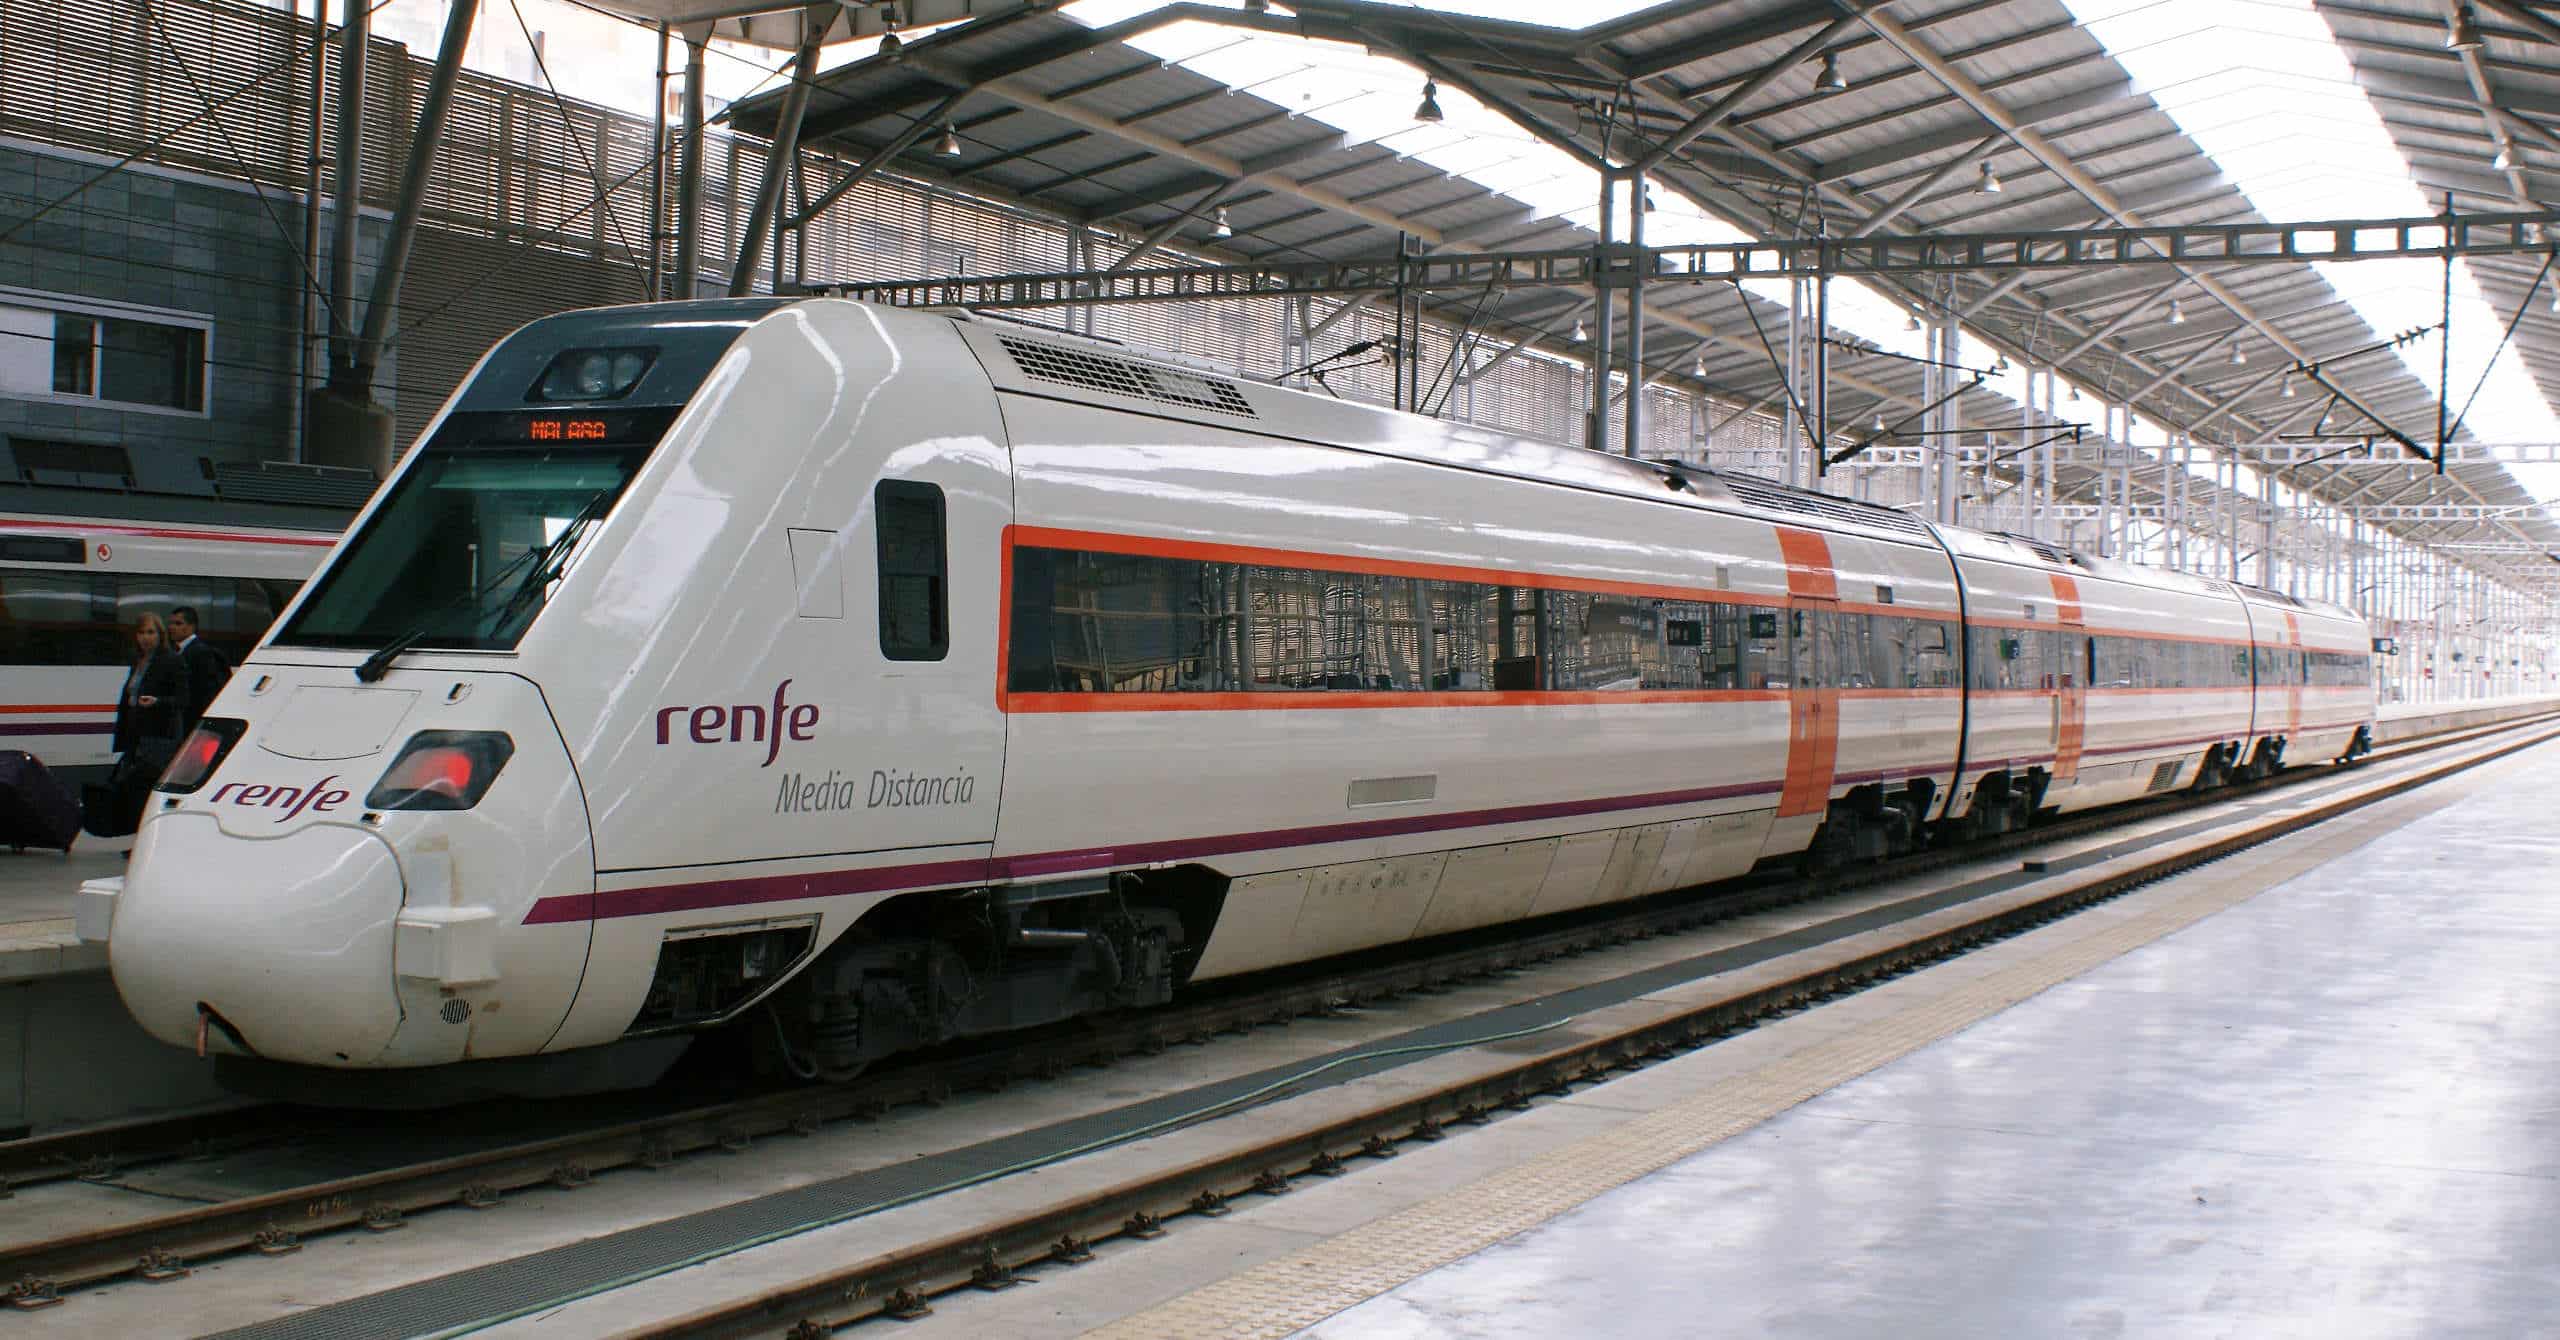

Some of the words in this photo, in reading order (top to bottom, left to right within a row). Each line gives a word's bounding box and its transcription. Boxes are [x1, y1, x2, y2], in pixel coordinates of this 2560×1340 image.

[656, 678, 819, 768] renfe
[209, 775, 350, 823] renfe
[775, 770, 854, 814] Media
[867, 766, 974, 808] Distancia
